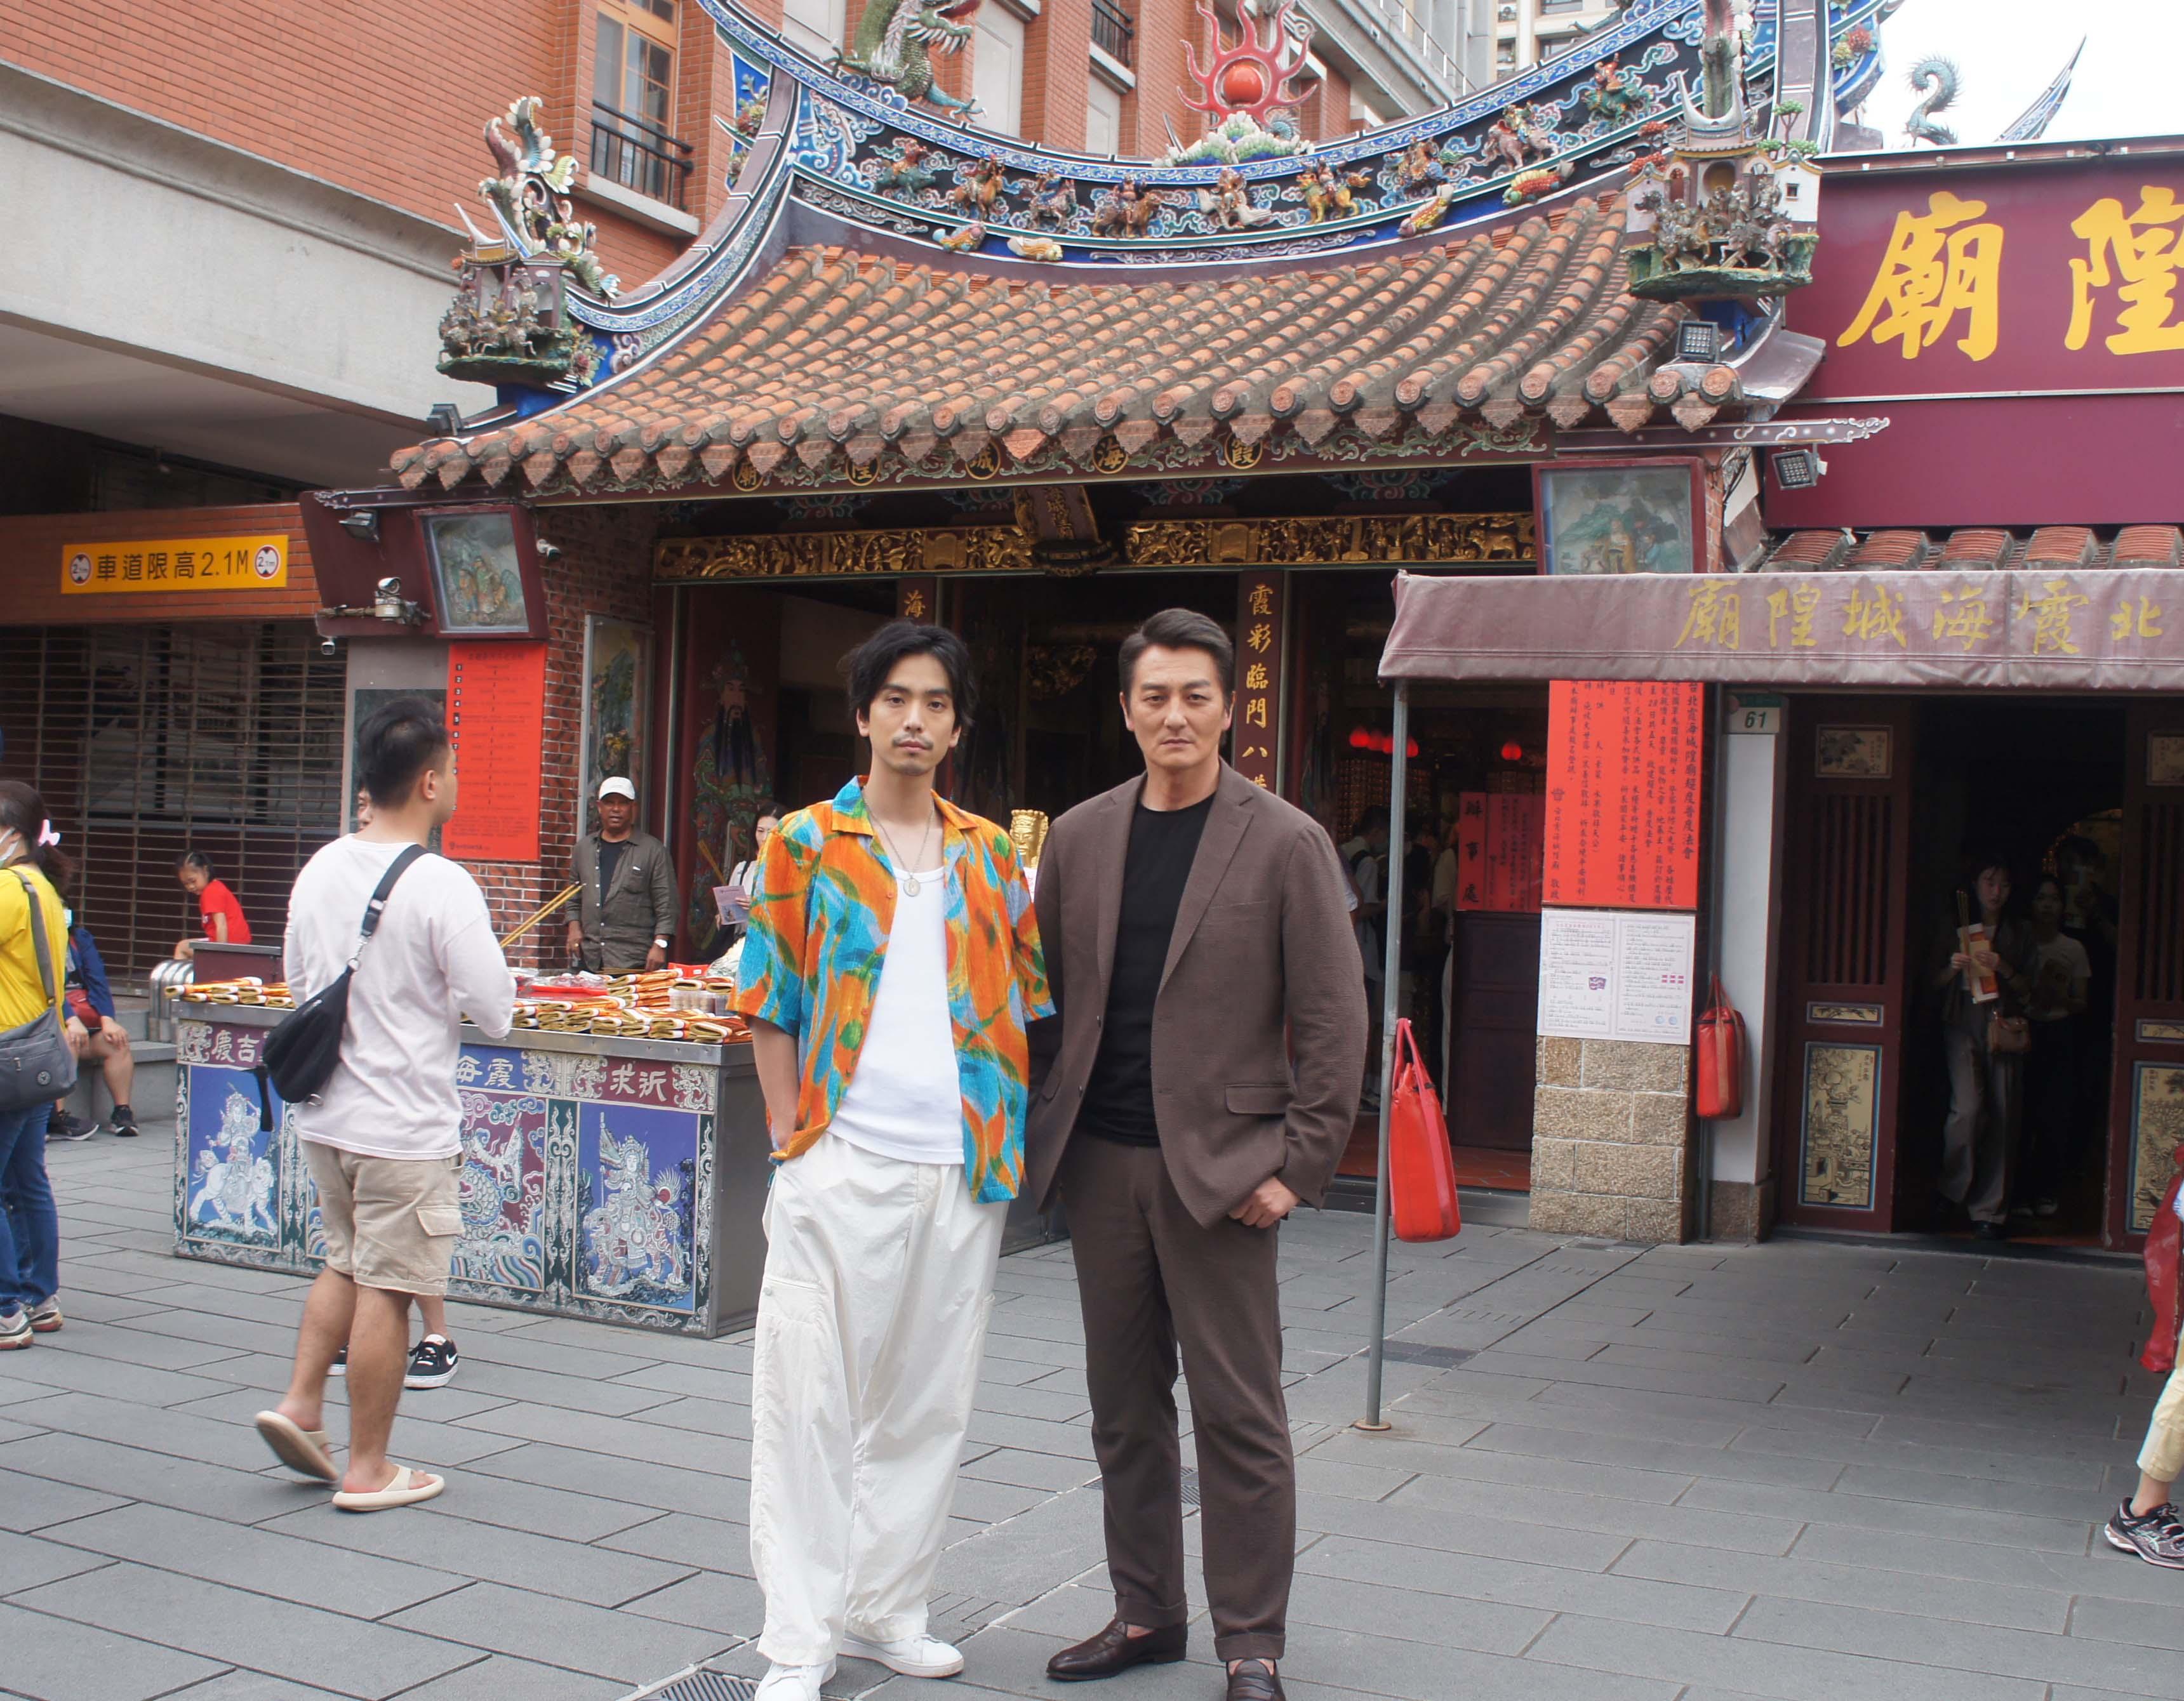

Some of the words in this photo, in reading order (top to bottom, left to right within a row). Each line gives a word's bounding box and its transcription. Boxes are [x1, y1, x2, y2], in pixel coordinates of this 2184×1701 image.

[96, 550, 249, 581] 車道限高2.1M
[1745, 711, 1767, 729] 61
